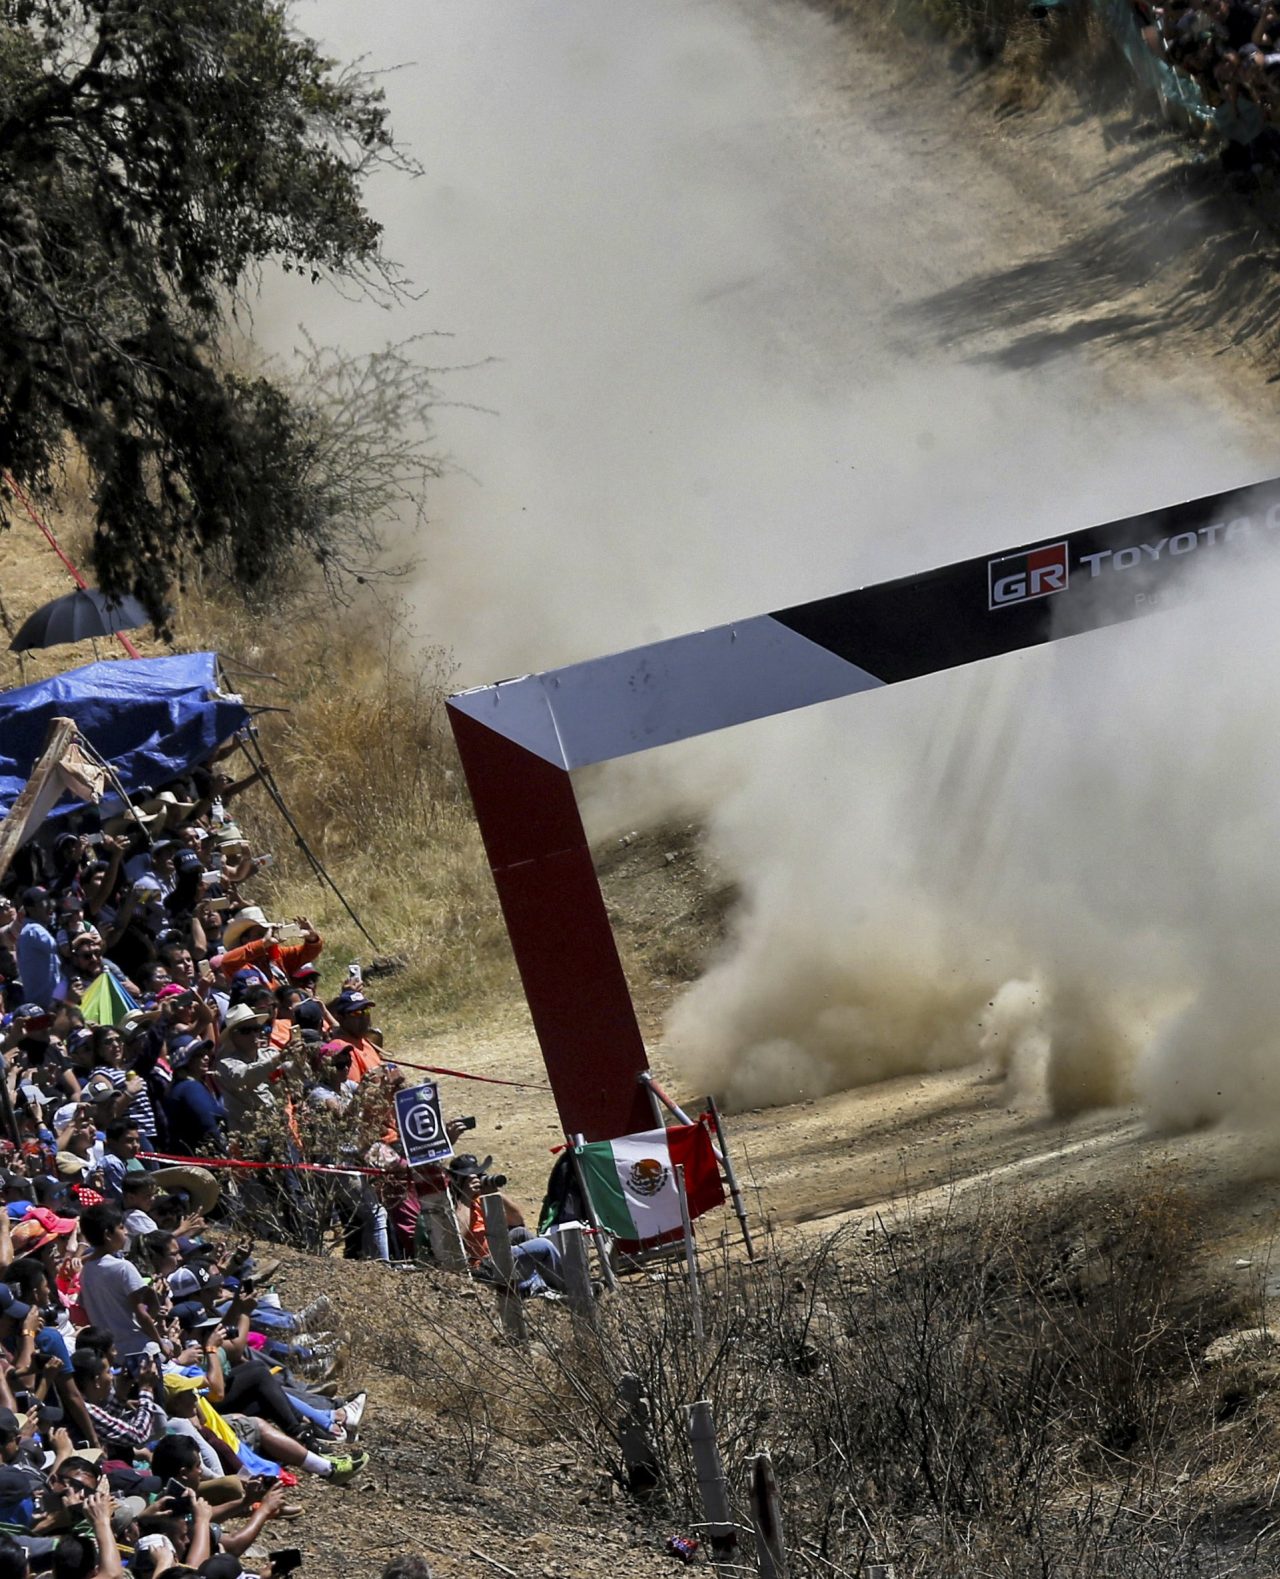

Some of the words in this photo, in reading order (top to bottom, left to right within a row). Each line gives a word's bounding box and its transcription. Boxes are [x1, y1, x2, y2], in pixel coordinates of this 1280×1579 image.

[993, 563, 1064, 602] GR
[1080, 516, 1252, 578] TOYOTA
[413, 1110, 434, 1135] E
